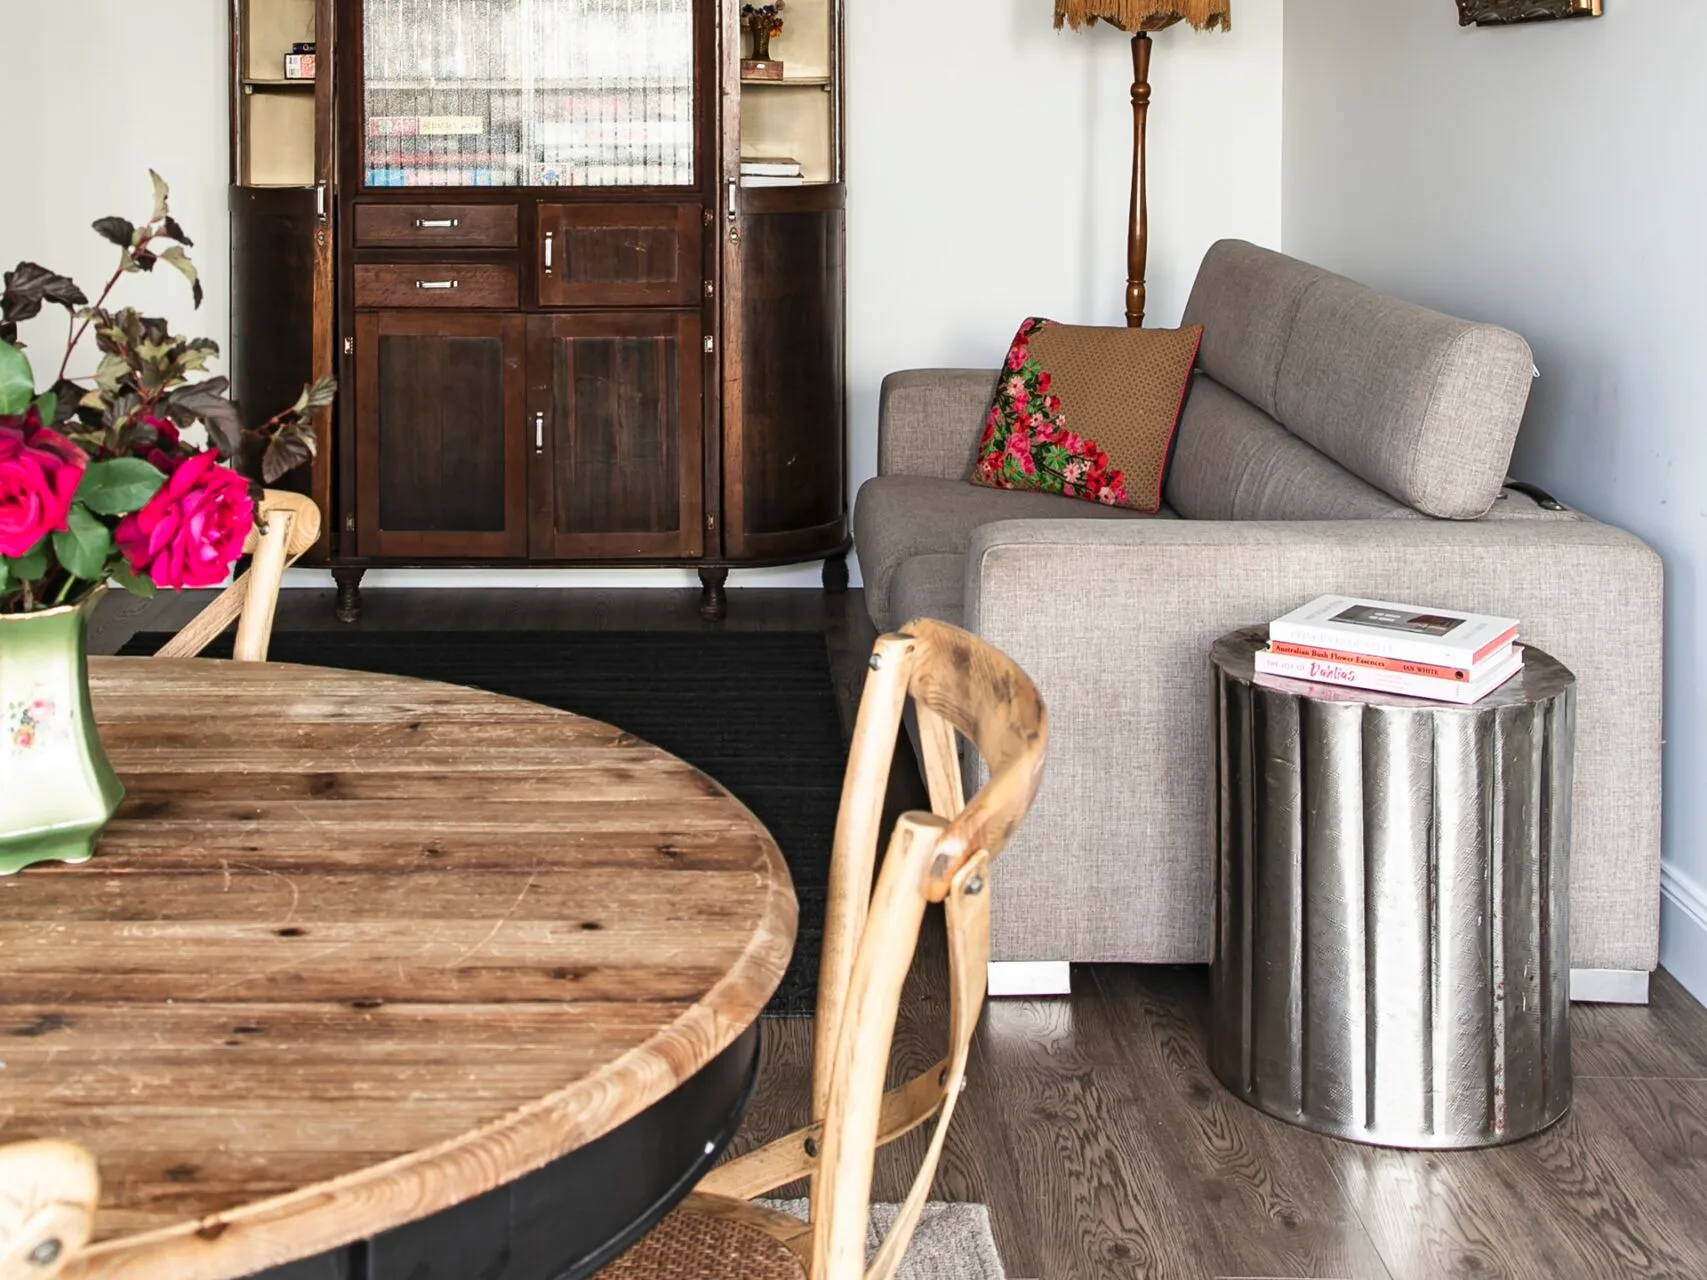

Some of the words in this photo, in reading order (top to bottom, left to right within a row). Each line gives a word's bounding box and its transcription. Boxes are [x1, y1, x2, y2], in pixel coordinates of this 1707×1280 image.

[1275, 645, 1309, 656] Australian
[1311, 650, 1329, 659] Bush
[1331, 652, 1354, 662] Flower
[1356, 656, 1385, 667] Essences
[1309, 661, 1356, 682] Dahlias
[1417, 667, 1439, 675] WHITE
